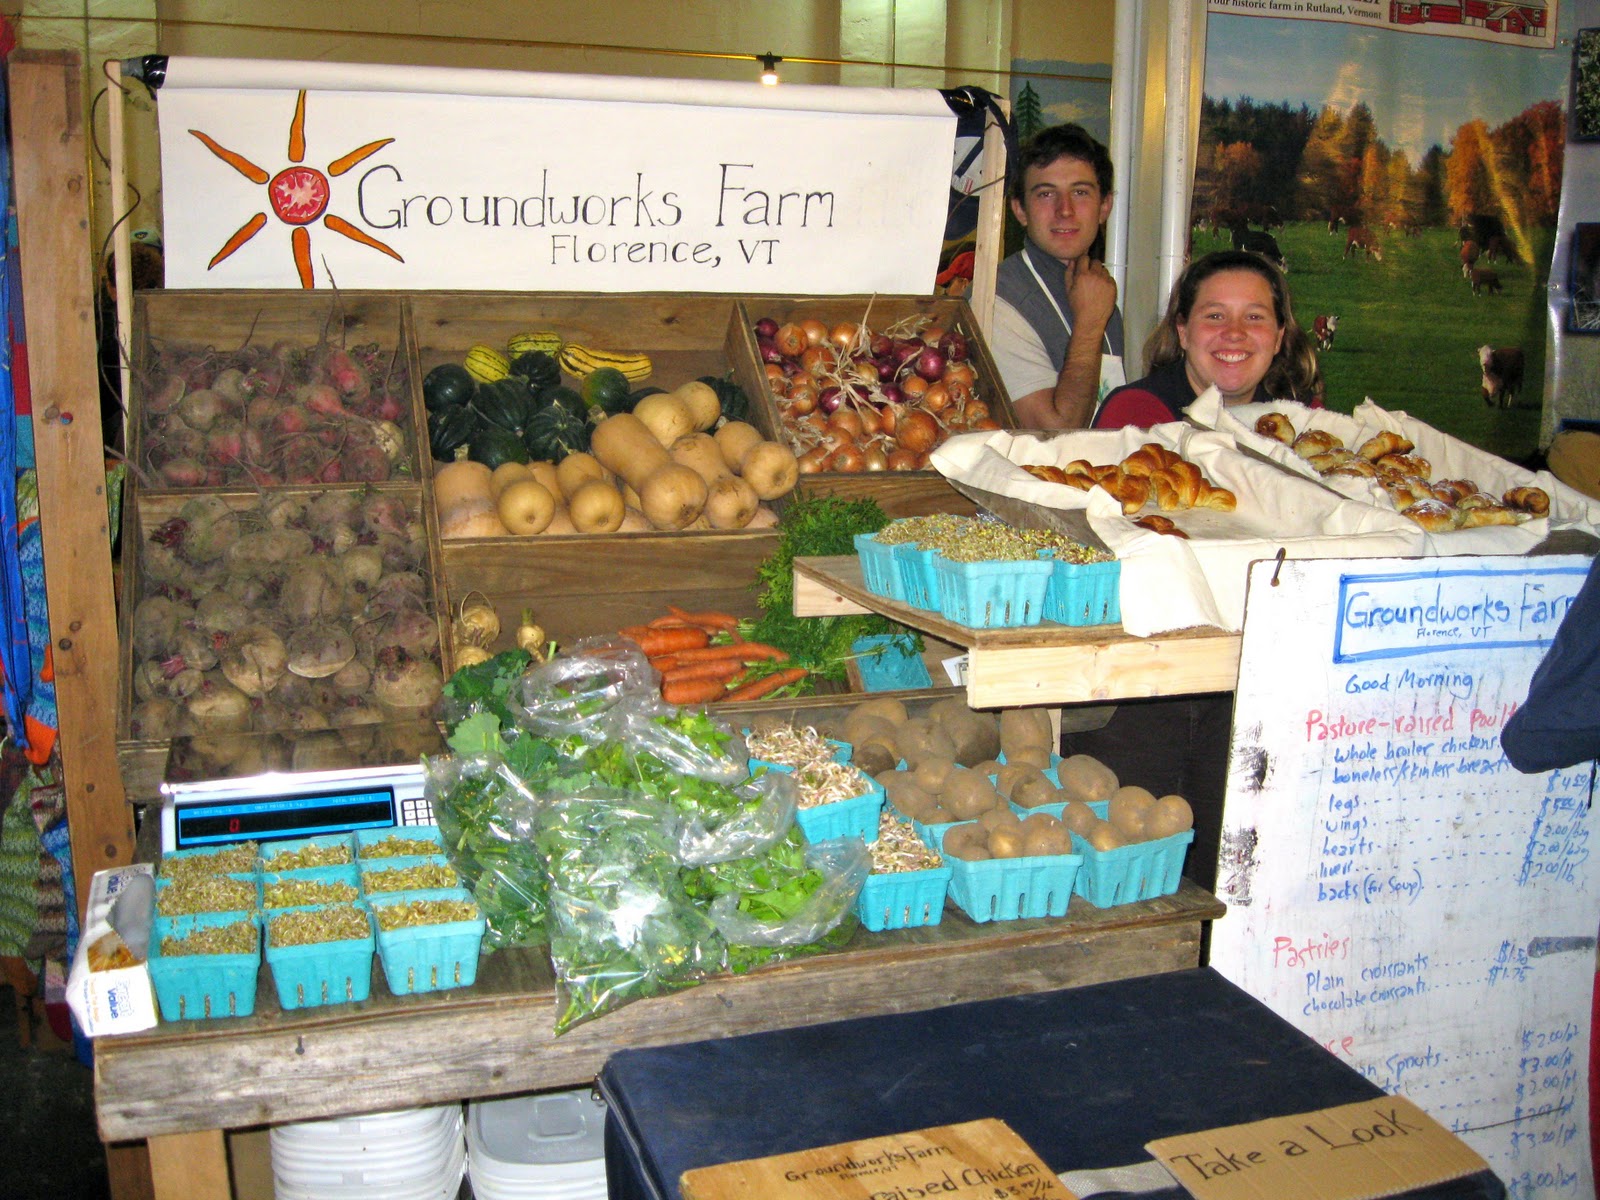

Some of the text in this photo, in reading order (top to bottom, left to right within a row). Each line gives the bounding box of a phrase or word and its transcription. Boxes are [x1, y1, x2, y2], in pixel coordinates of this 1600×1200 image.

[1232, 0, 1266, 9] historic
[1269, 0, 1291, 11] farm
[1294, 2, 1303, 11] in
[1306, 3, 1345, 15] Rutland,
[1346, 6, 1382, 19] Vermont
[357, 163, 835, 229] Groundworks Farm
[551, 235, 781, 268] Florence, VT
[1346, 583, 1511, 629] Groundworks
[1416, 626, 1492, 639] Florence, VT
[1345, 667, 1473, 699] Good Morning
[1305, 701, 1518, 742] Pasture-raised Poult
[1384, 740, 1435, 760] broiler
[1328, 793, 1360, 818] legs
[1325, 816, 1368, 840] wings
[1322, 836, 1374, 856] hearts
[1272, 933, 1351, 968] Pastries
[1305, 969, 1345, 996] Plain
[1169, 1147, 1266, 1180] Take
[1279, 1139, 1309, 1158] a
[1304, 1108, 1424, 1150] Look
[785, 1144, 953, 1182] Groundworks Farm
